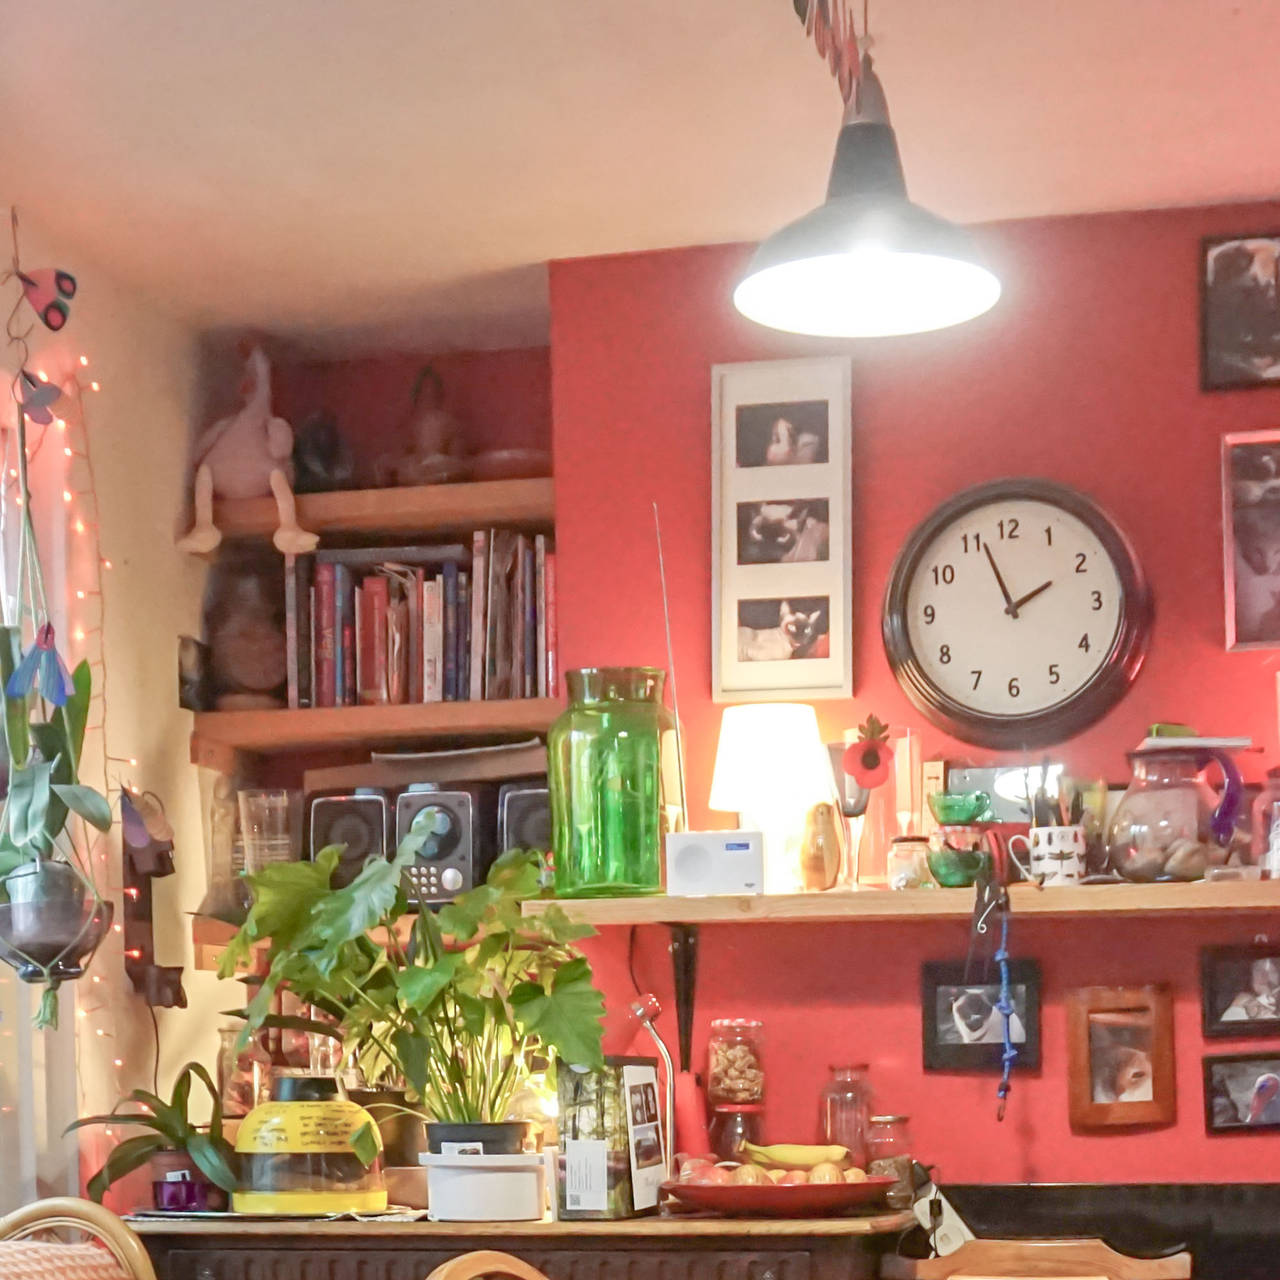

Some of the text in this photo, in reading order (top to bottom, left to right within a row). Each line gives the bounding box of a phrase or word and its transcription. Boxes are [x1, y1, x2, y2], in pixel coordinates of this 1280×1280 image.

[997, 518, 1020, 540] 12
[1044, 526, 1053, 546] 1
[962, 533, 980, 553] 11
[1075, 553, 1087, 573] 2
[932, 565, 955, 585] 10
[1091, 590, 1103, 610] 3
[923, 605, 935, 625] 9
[1078, 633, 1090, 653] 4
[939, 644, 951, 664] 8
[970, 670, 983, 690] 7
[1048, 664, 1060, 684] 5
[1008, 677, 1020, 697] 6
